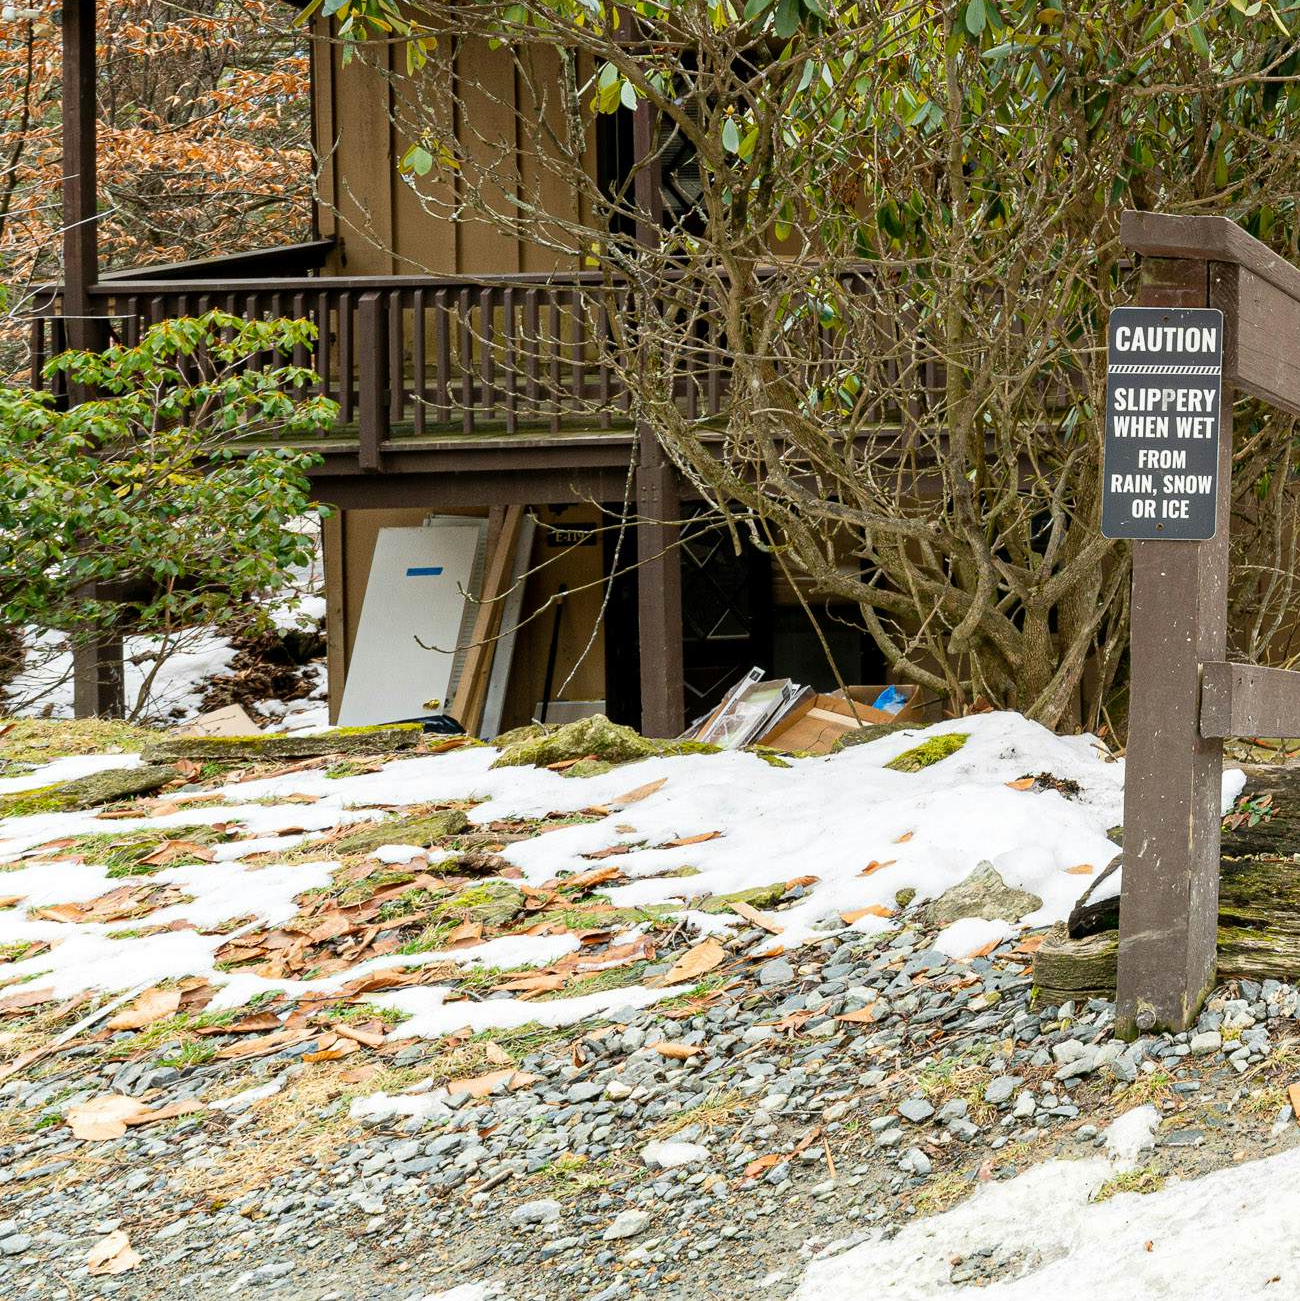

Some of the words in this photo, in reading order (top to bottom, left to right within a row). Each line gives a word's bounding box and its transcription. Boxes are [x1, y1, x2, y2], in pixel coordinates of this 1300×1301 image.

[1115, 326, 1216, 353] CAUTION
[1114, 387, 1216, 412] SLIPPERY
[1113, 416, 1169, 438] WHEN
[1176, 417, 1215, 439] WET
[1138, 450, 1186, 469] FROM
[1111, 475, 1157, 497] RAIN,
[1163, 475, 1212, 494] SNOW
[1132, 499, 1156, 518] OR
[1161, 500, 1190, 519] ICE
